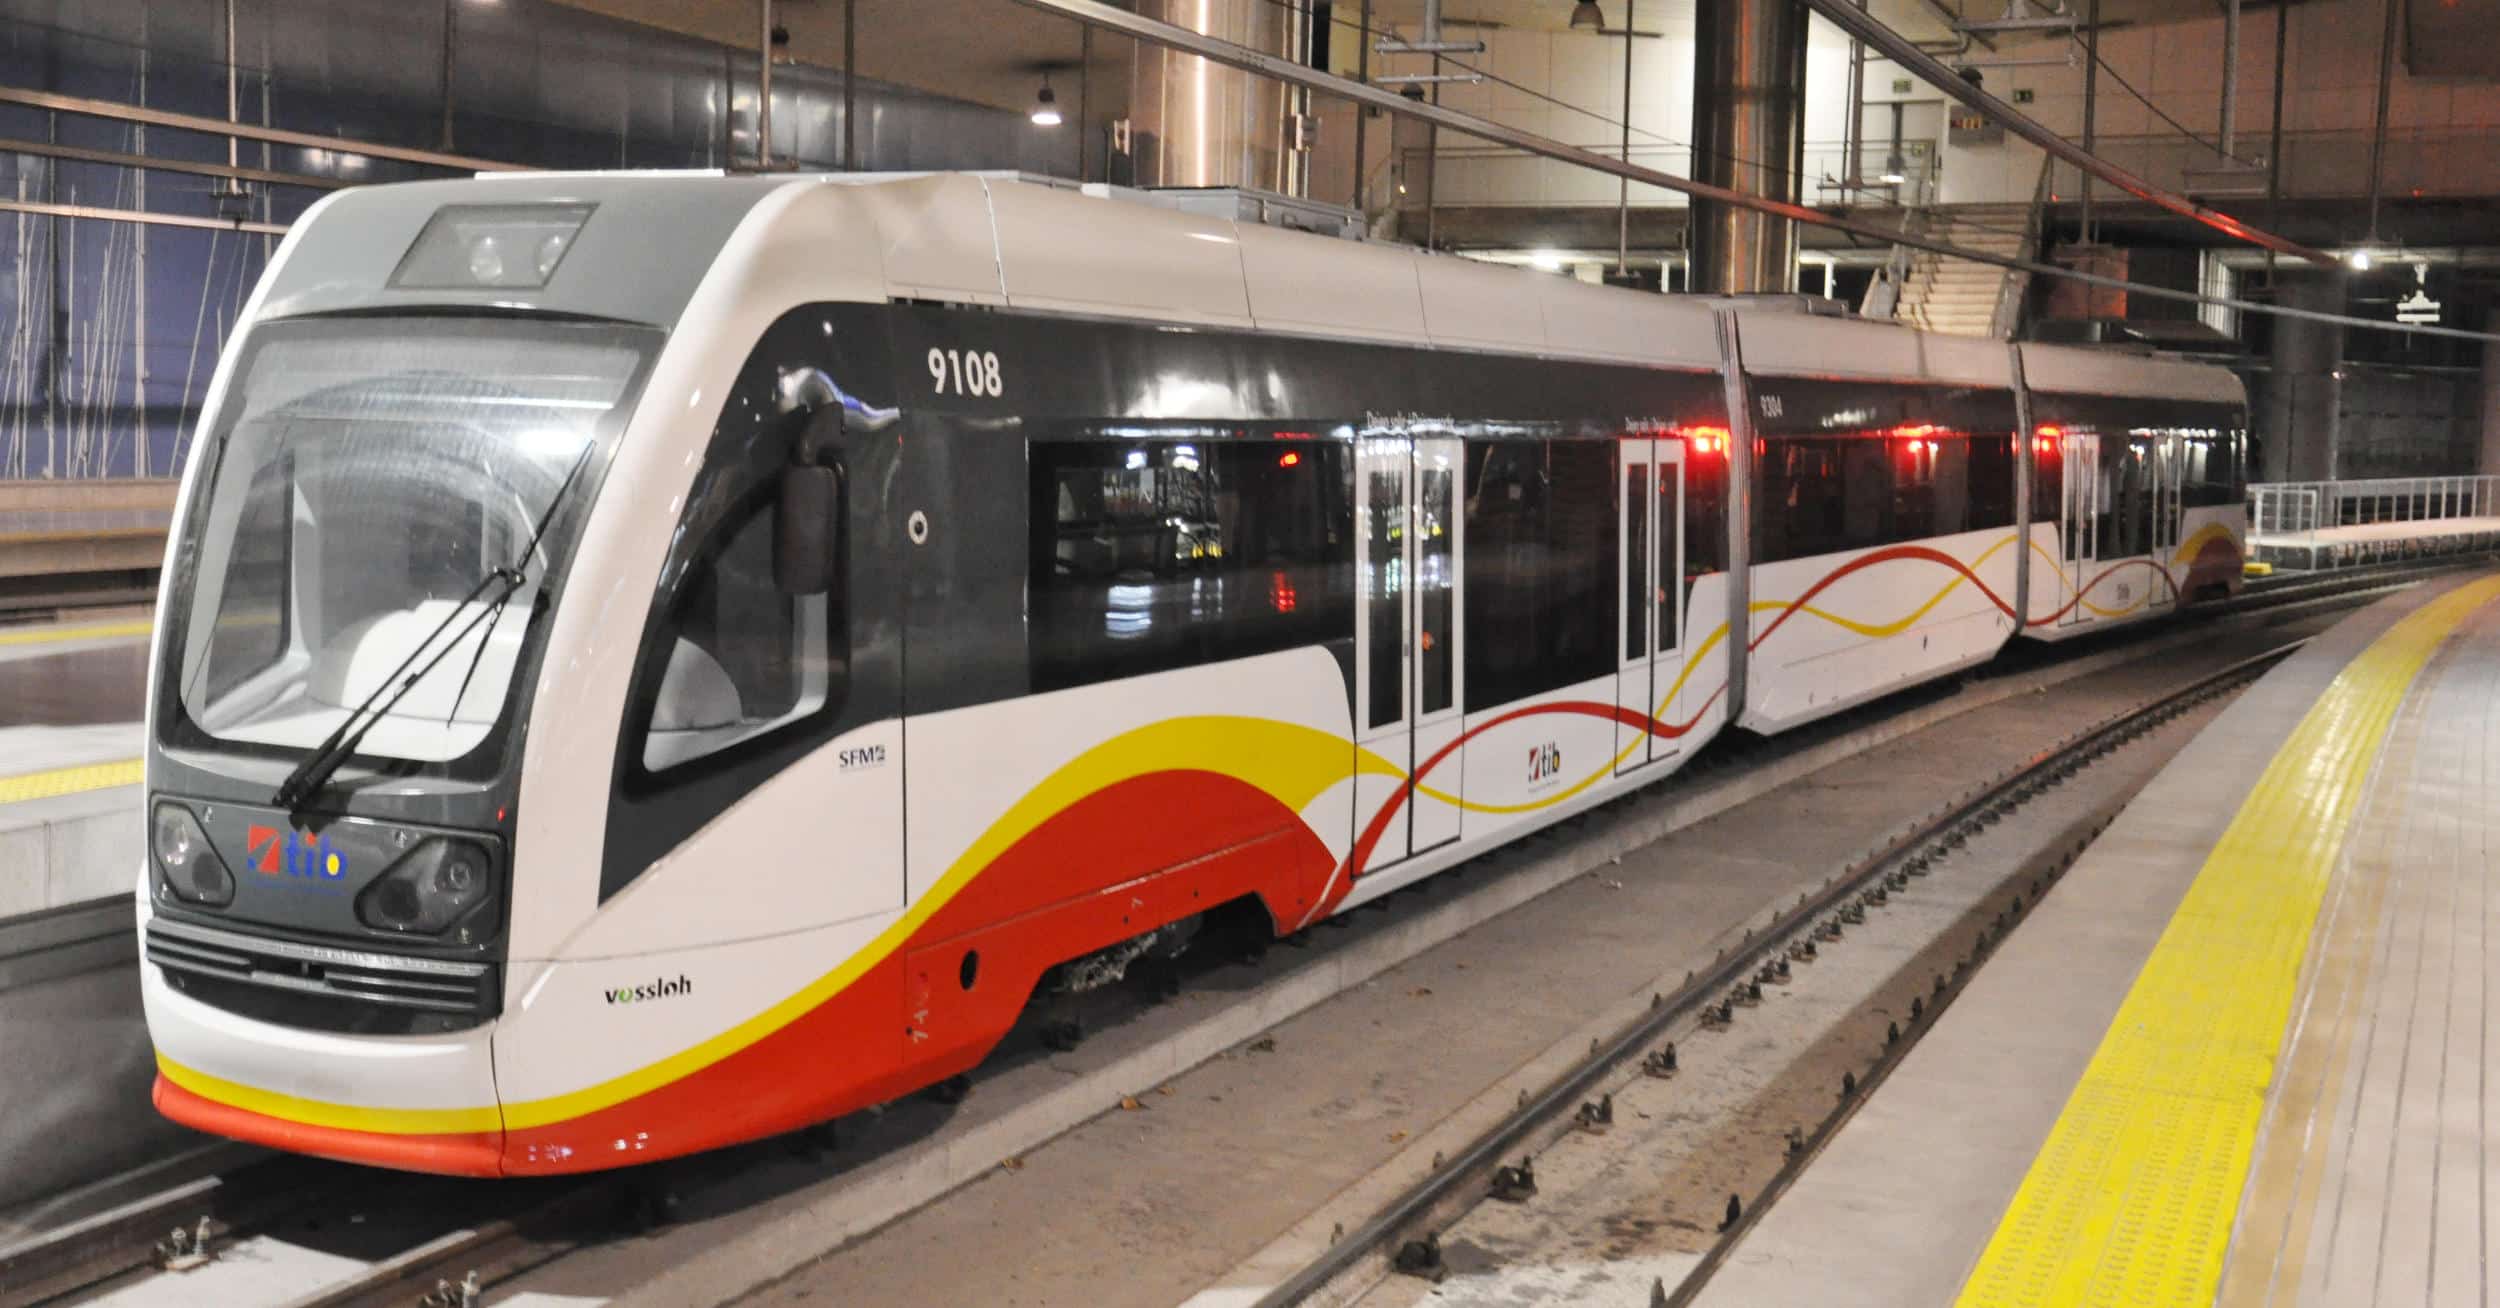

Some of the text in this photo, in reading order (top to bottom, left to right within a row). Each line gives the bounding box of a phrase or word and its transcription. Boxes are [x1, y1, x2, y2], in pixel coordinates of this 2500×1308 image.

[928, 347, 1003, 398] 9108
[839, 746, 875, 769] SFM
[1542, 740, 1561, 777] tib
[285, 831, 349, 881] tib
[604, 974, 692, 1004] vossloh
